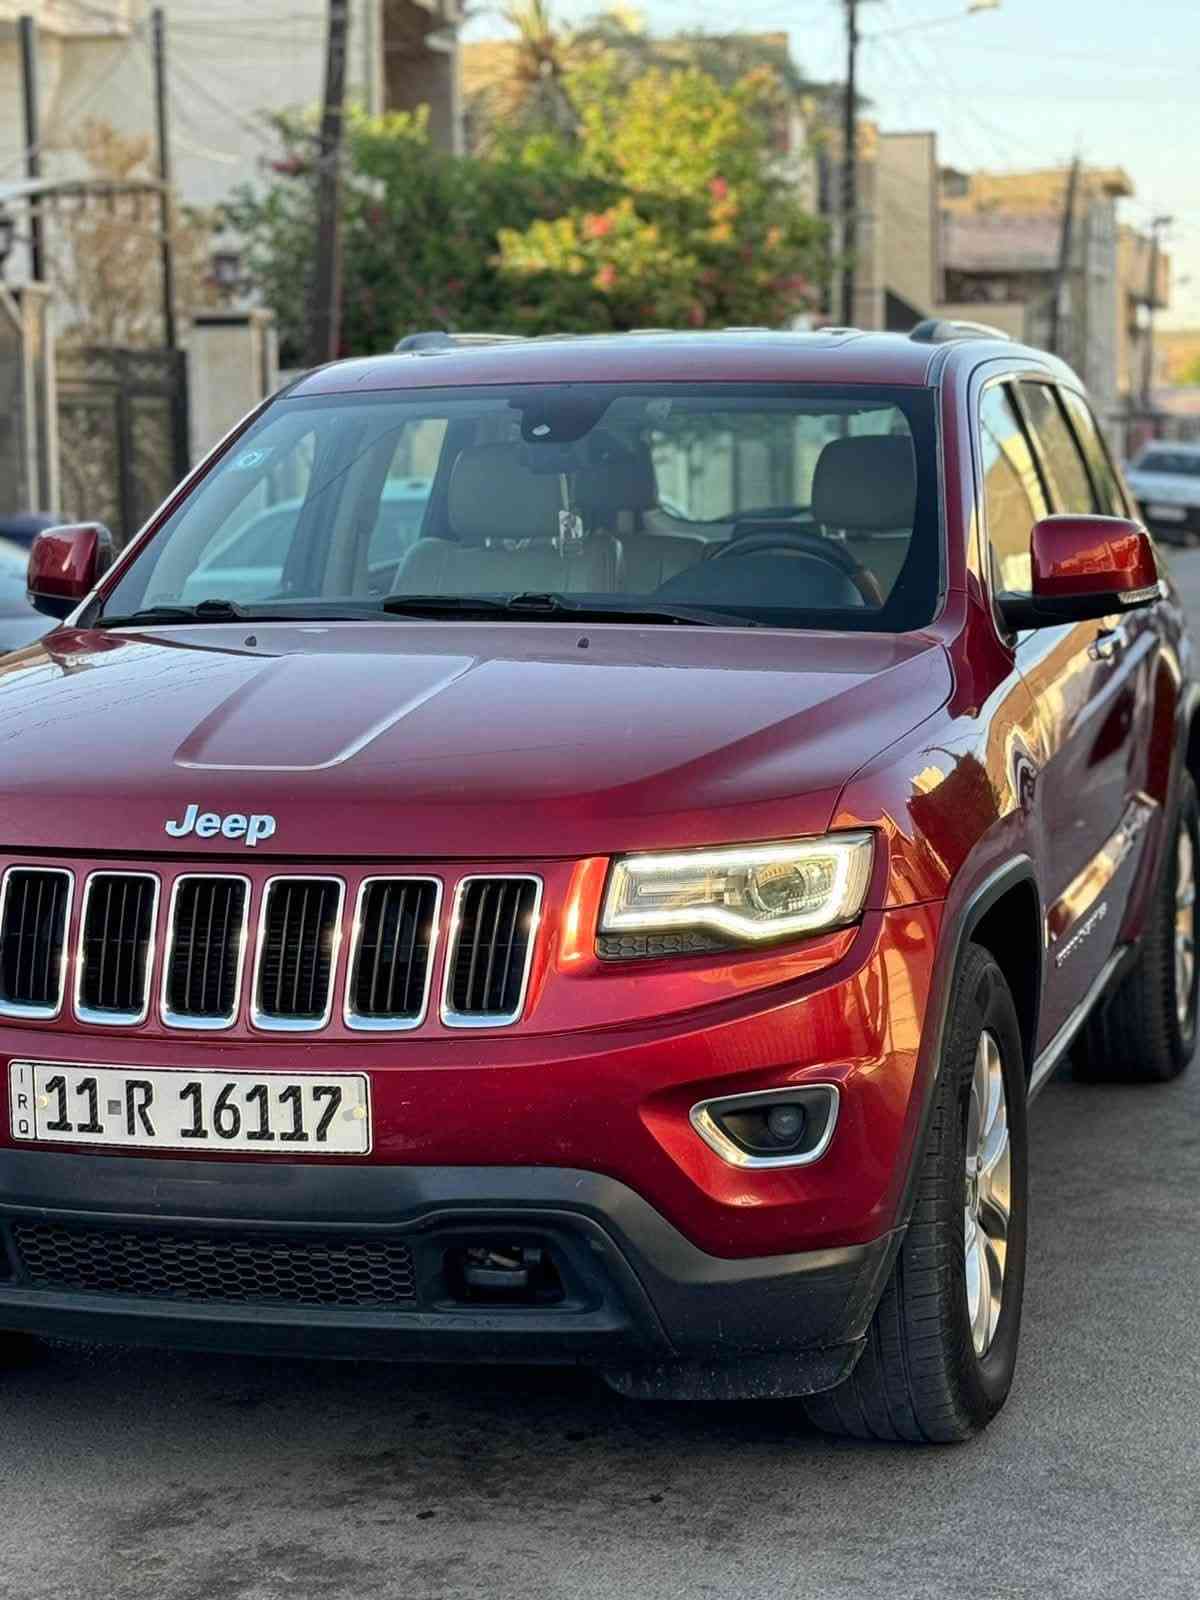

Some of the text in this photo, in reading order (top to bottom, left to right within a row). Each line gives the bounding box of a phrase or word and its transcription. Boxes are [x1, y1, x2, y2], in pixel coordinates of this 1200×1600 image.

[165, 804, 276, 847] Jeep
[17, 1068, 29, 1134] IRQ
[179, 1082, 342, 1142] 16117
